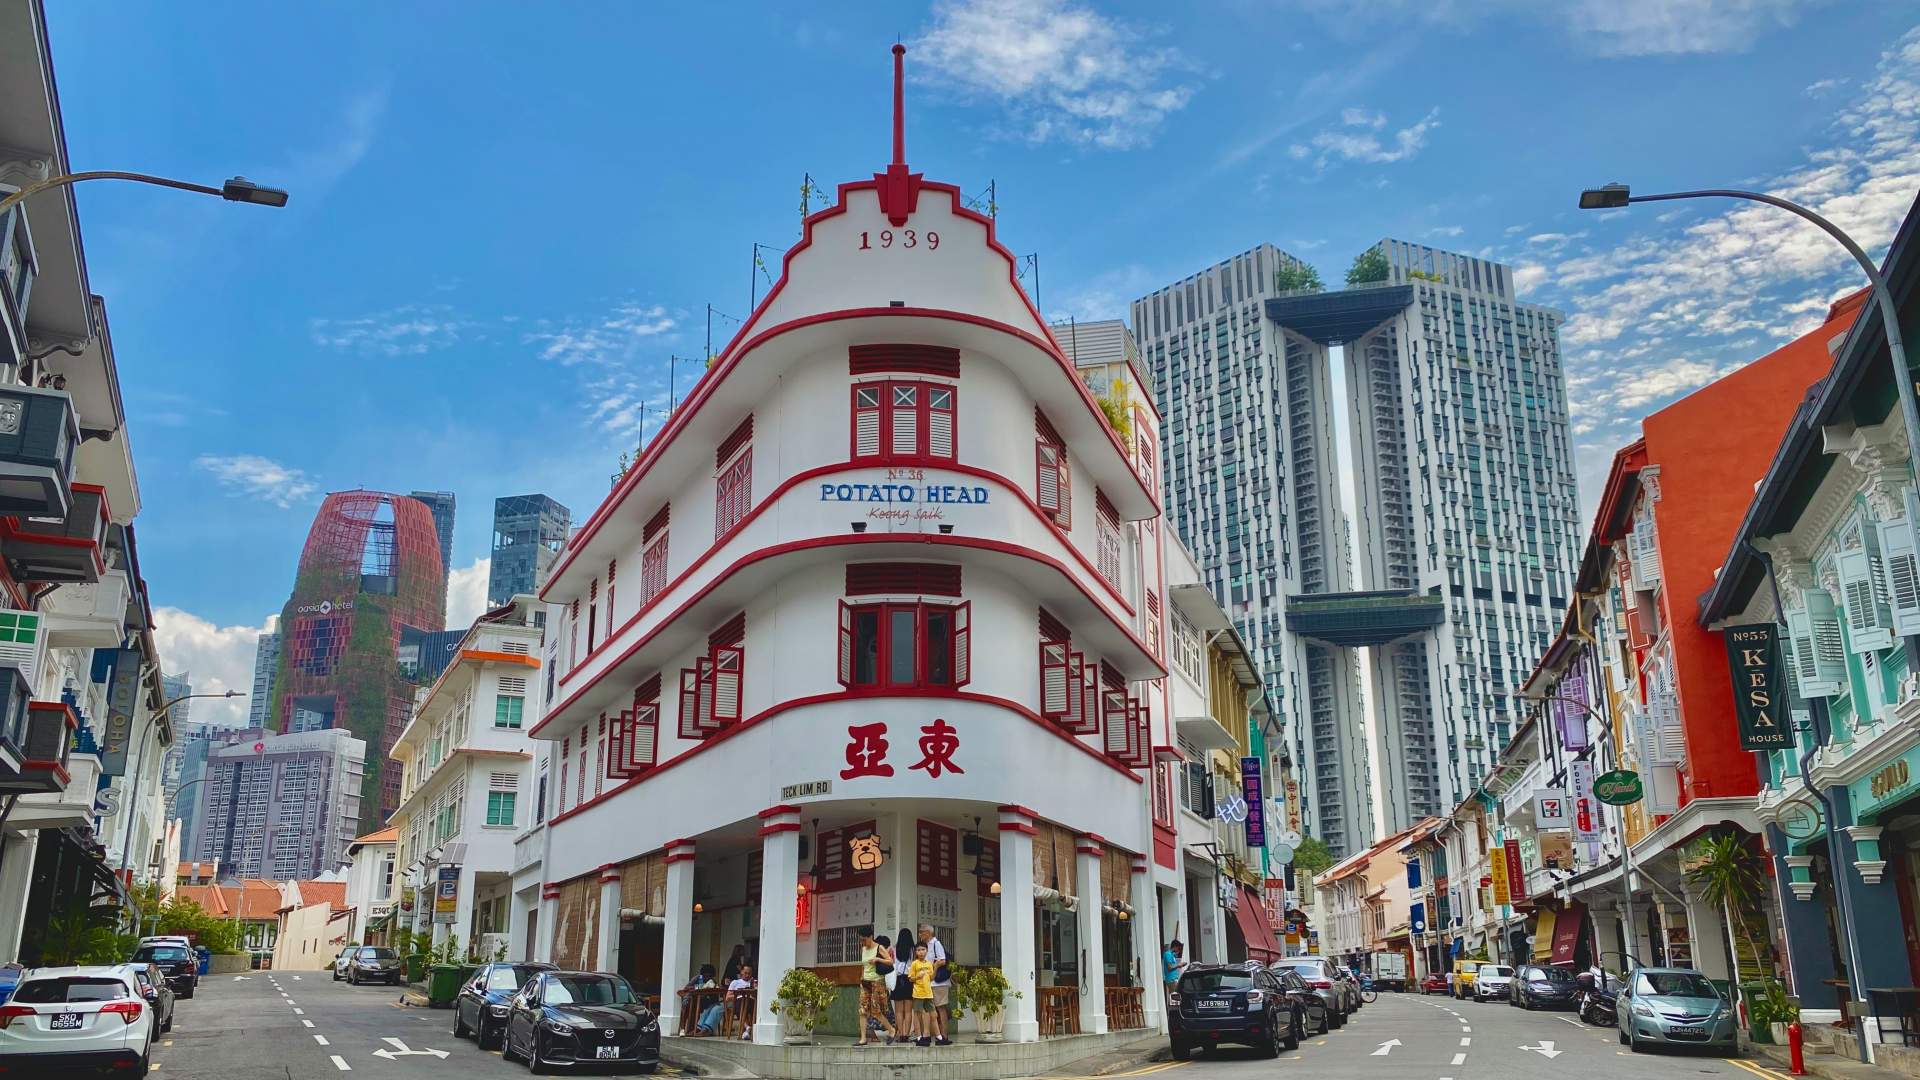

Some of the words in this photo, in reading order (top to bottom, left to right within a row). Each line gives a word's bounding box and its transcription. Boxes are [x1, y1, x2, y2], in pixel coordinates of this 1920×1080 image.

[858, 229, 940, 250] 1939
[908, 470, 924, 481] 36
[821, 484, 915, 503] POTATO
[926, 485, 989, 504] HEAD
[868, 507, 910, 525] Keong
[914, 508, 943, 520] Saik
[298, 604, 320, 613] oasia
[1748, 734, 1785, 743] HOUSE
[782, 787, 797, 798] TECK
[799, 783, 814, 795] LIM
[816, 782, 828, 794] RD
[1573, 764, 1582, 798] FOCUS
[1577, 800, 1587, 831] MUSIC
